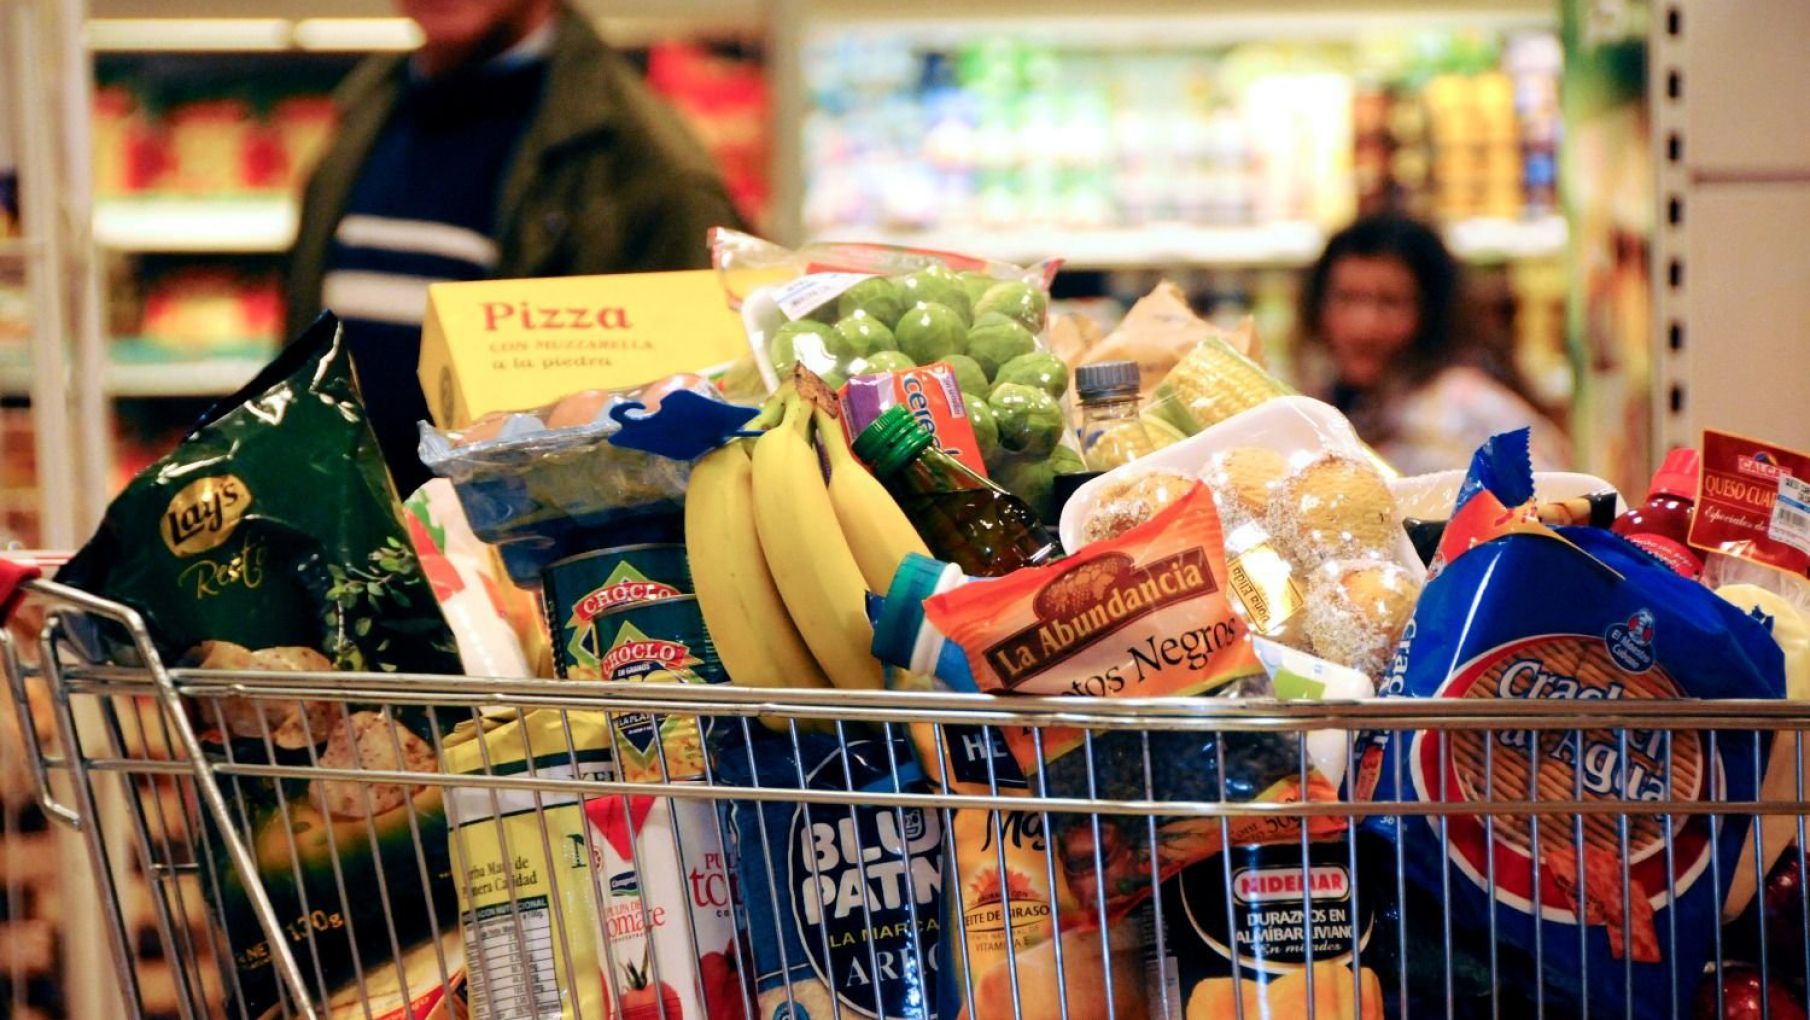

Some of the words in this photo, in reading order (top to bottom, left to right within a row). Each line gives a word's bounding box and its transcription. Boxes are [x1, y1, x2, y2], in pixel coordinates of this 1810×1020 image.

[483, 301, 632, 332] Pizza
[542, 355, 613, 370] piedra
[903, 373, 961, 455] cerel
[1705, 475, 1745, 500] QUESO
[168, 483, 238, 545] Lay's
[583, 582, 672, 615] CHOCLO
[996, 645, 1033, 677] La
[1037, 561, 1205, 651] Abundancia
[602, 643, 676, 675] CHOCLO
[1127, 617, 1238, 683] Negros
[801, 810, 941, 873] BLU
[802, 856, 942, 925] PATN
[986, 909, 1001, 922] DE
[1247, 909, 1327, 927] DURAZNOS
[1329, 908, 1346, 922] EN
[829, 929, 857, 948] LA
